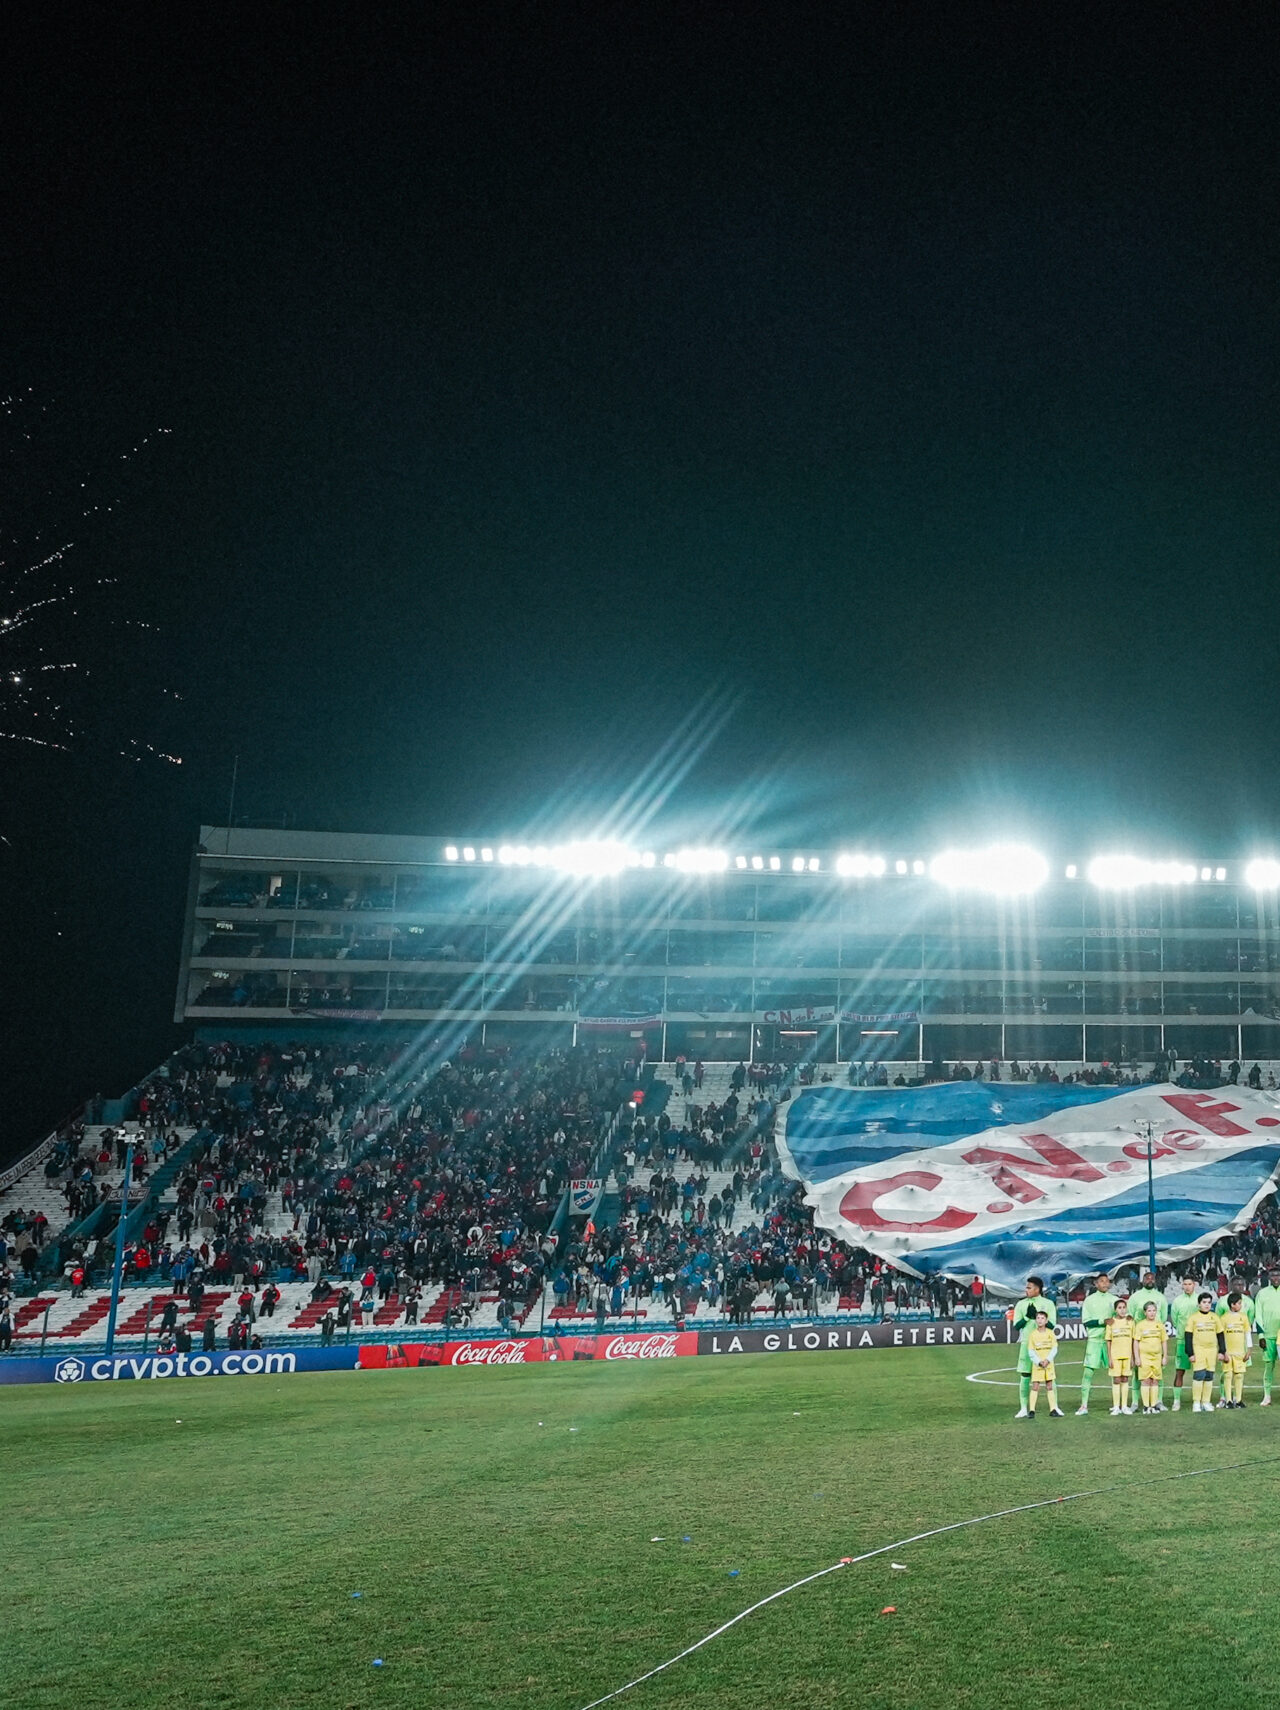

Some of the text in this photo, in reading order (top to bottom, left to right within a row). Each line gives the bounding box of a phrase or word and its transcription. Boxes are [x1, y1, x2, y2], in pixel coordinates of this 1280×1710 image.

[573, 1181, 599, 1190] NSNA
[605, 1334, 680, 1360] Coca-Cola
[712, 1325, 996, 1353] LA GLORIA ETERNA
[91, 1352, 297, 1380] crypto.com
[451, 1341, 530, 1366] Coca-Cola
